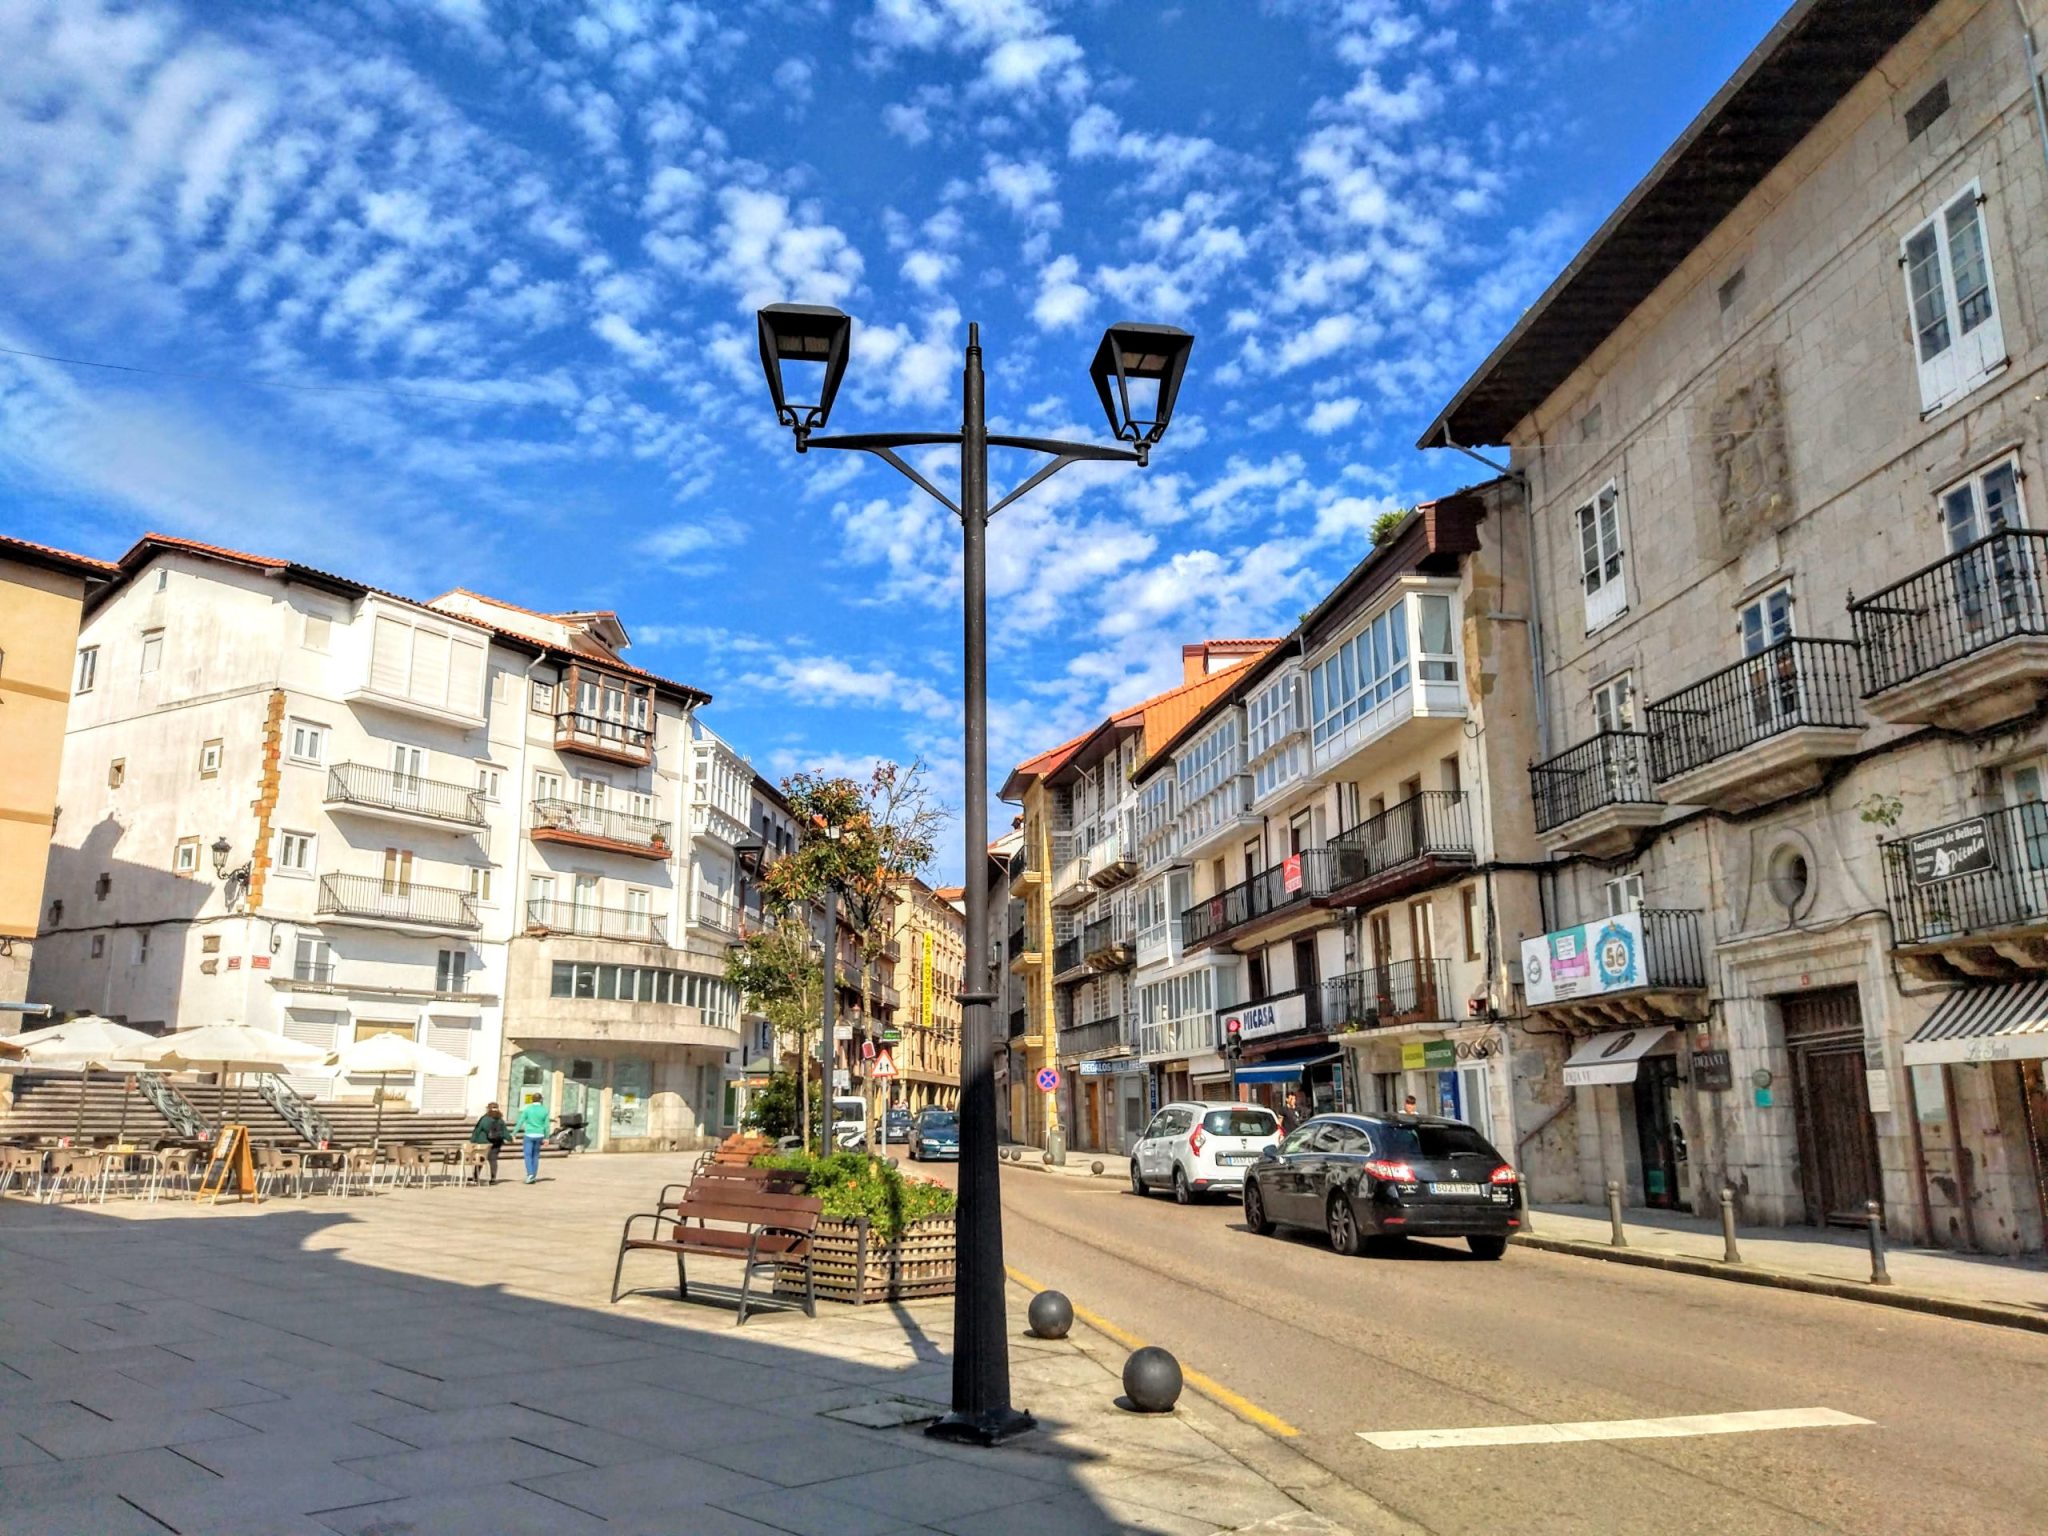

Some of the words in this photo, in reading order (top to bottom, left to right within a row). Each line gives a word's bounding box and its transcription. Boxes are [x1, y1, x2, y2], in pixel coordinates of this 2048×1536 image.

[1913, 836, 1945, 852] Instituto
[1945, 832, 1954, 843] de
[1954, 825, 1983, 840] Belleza
[1243, 1005, 1275, 1031] MICASA
[1082, 1062, 1112, 1073] REGALOS
